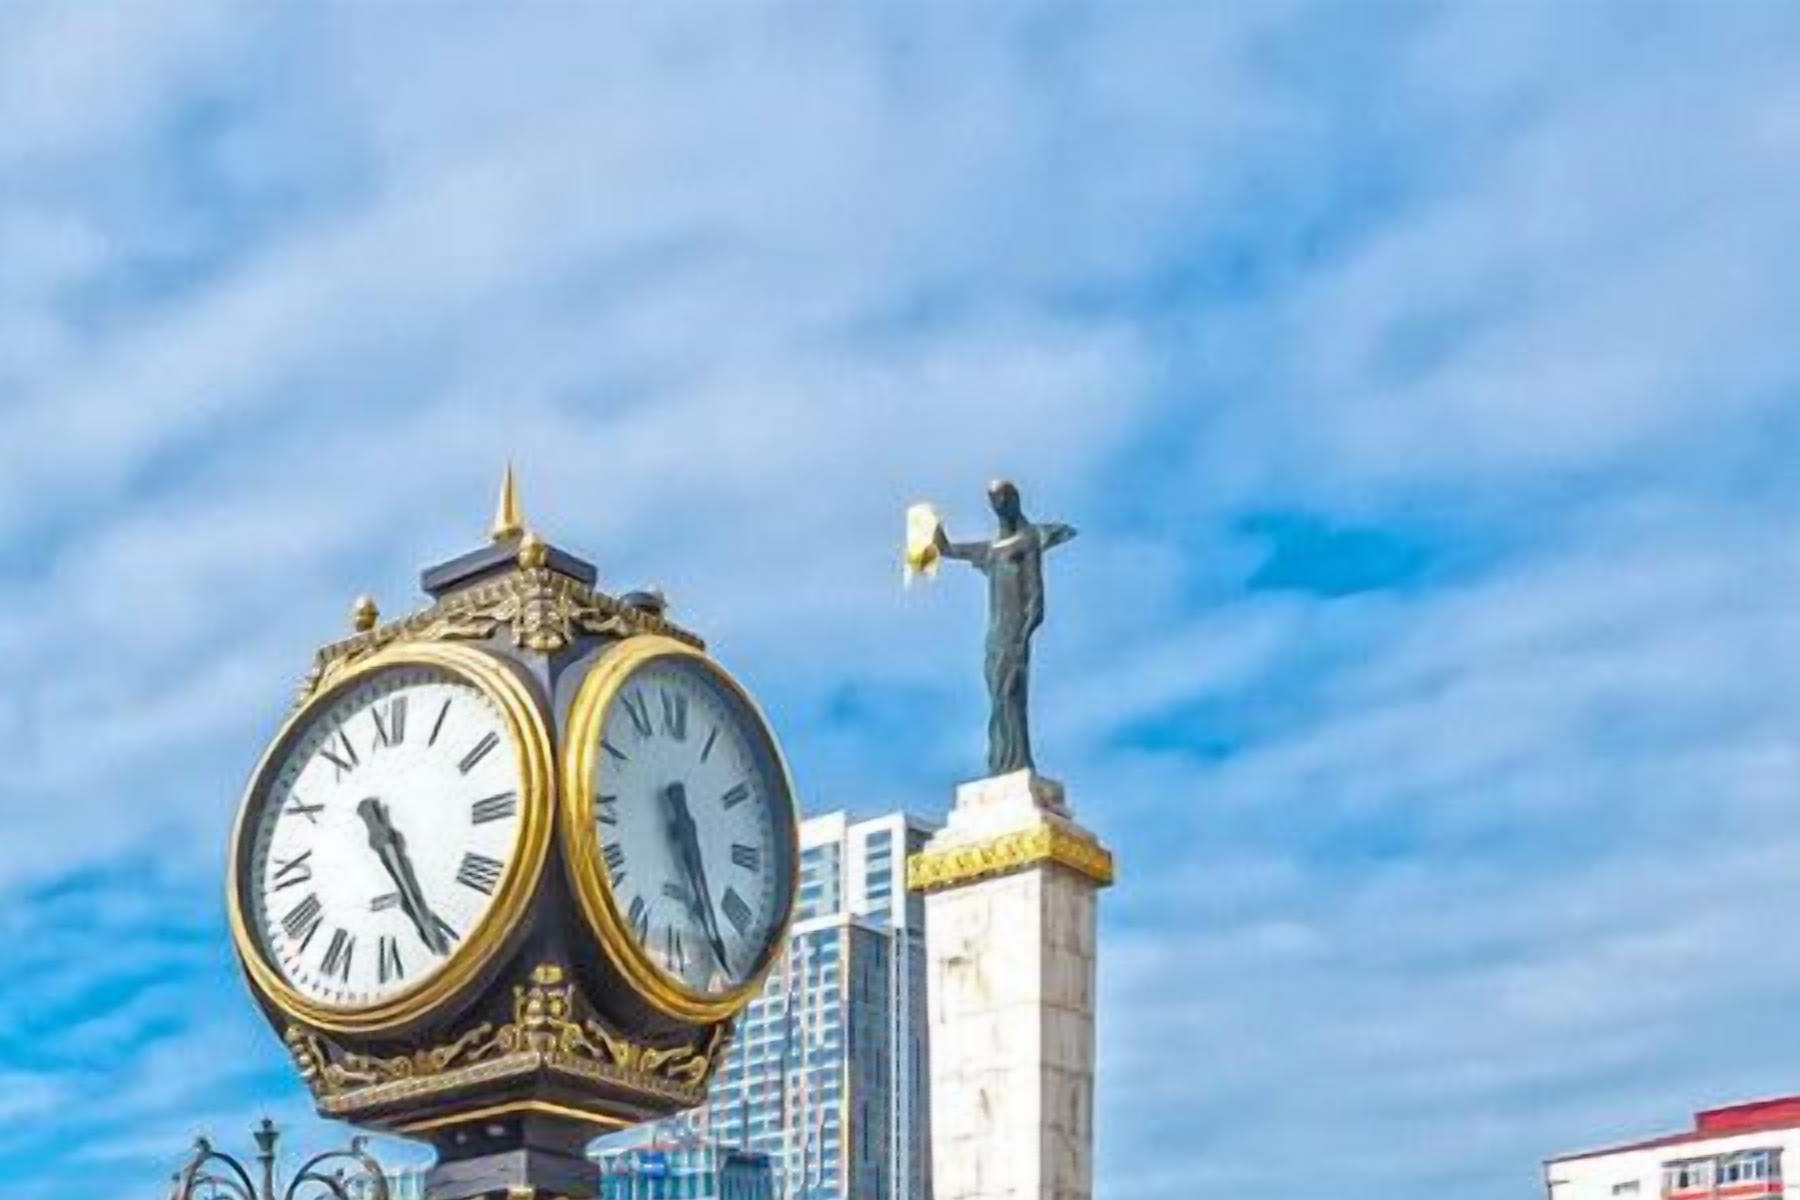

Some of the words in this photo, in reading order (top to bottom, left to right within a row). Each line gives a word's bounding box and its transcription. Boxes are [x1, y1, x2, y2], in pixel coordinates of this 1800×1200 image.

[319, 729, 360, 784] XI
[457, 732, 500, 776] II
[284, 793, 325, 825] X
[471, 791, 518, 826] III
[272, 848, 312, 892] IX
